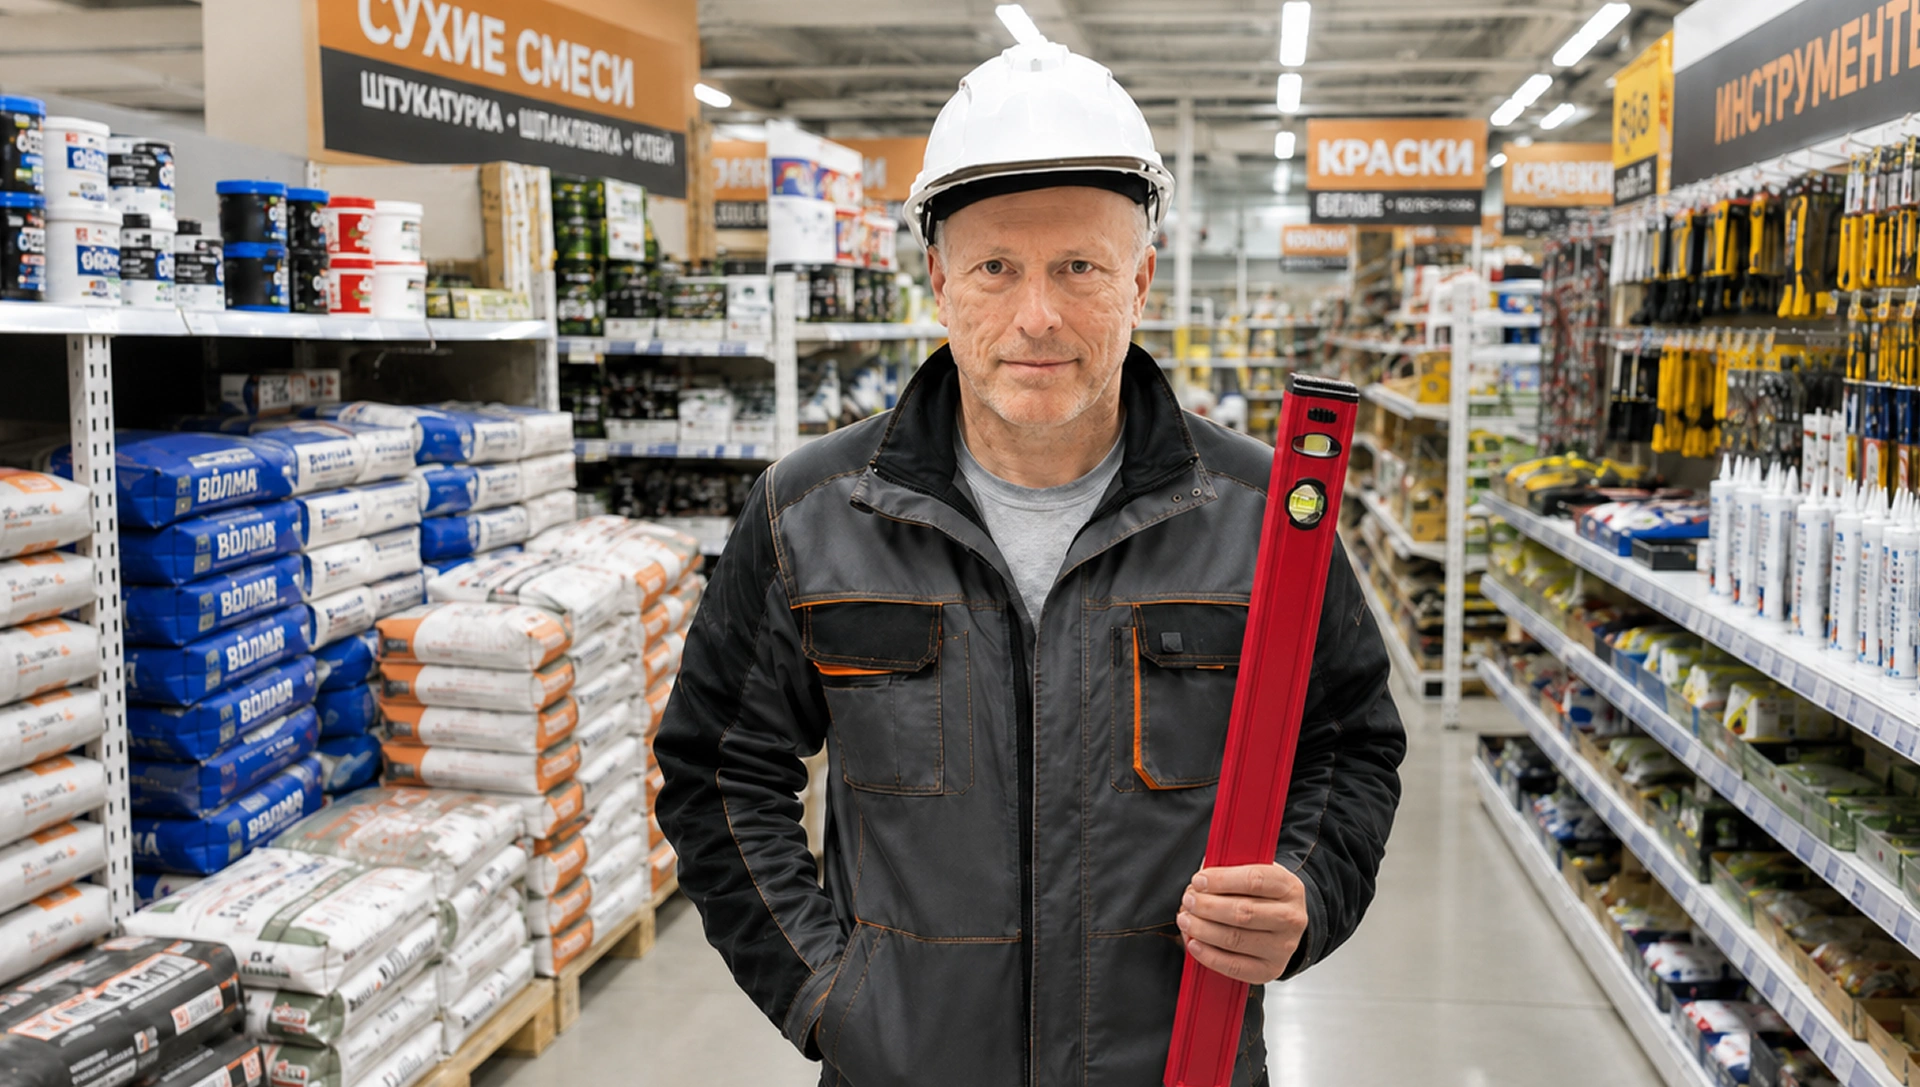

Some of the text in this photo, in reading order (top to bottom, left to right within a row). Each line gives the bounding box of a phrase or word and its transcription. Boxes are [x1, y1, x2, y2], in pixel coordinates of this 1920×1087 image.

[358, 0, 635, 108] СУХИЕ СМЕСИ
[360, 70, 504, 134] ШТУКАТУРКА
[518, 107, 624, 157] ШПАКЛЕВКА
[1317, 138, 1475, 176] КРАСКИ
[1316, 192, 1384, 219] БЕЛЫЕ
